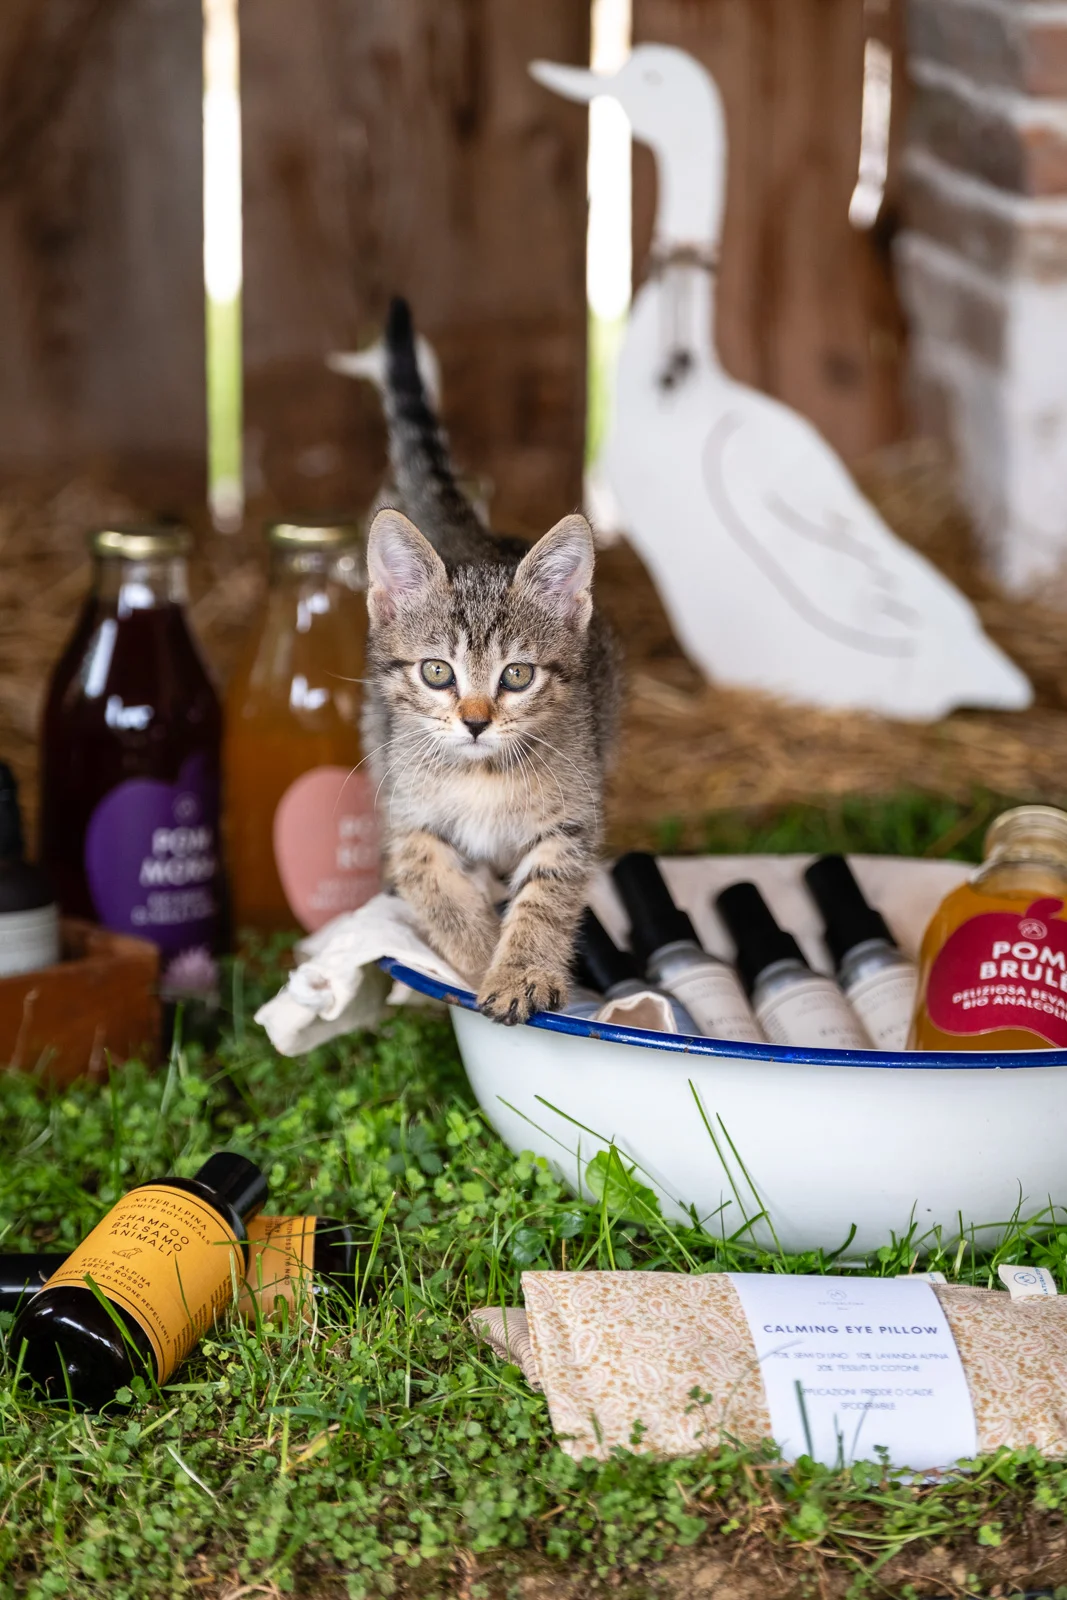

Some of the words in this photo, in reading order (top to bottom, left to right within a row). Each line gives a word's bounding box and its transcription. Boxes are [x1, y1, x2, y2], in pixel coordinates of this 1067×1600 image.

[992, 940, 1066, 972] POM
[952, 984, 1027, 1004] DELIZIOSA
[1031, 987, 1067, 1011] BEVA
[962, 996, 989, 1010] BIO
[135, 1197, 207, 1231] NATURALPINA
[160, 1208, 211, 1245] BOTANICALS
[108, 1229, 173, 1257] ANIMALI
[111, 1221, 183, 1252] BALSAMO
[117, 1214, 190, 1245] SHAMPOO
[81, 1257, 116, 1267] STELLA
[119, 1265, 151, 1288] ALPINA
[81, 1263, 111, 1271] ABETE
[114, 1269, 144, 1289] ROSSO
[101, 1273, 112, 1281] AD
[113, 1278, 141, 1299] AZIONE
[141, 1298, 171, 1346] REPELLENTE
[763, 1325, 839, 1335] CALMING
[845, 1325, 873, 1335] EYE
[879, 1326, 938, 1335] PILLOW
[875, 1352, 918, 1360] LAVANDA
[920, 1352, 949, 1360] ALPINA
[881, 1364, 920, 1372] COTONE
[799, 1388, 856, 1396] PPLICAZIONI
[905, 1388, 934, 1396] CALDE
